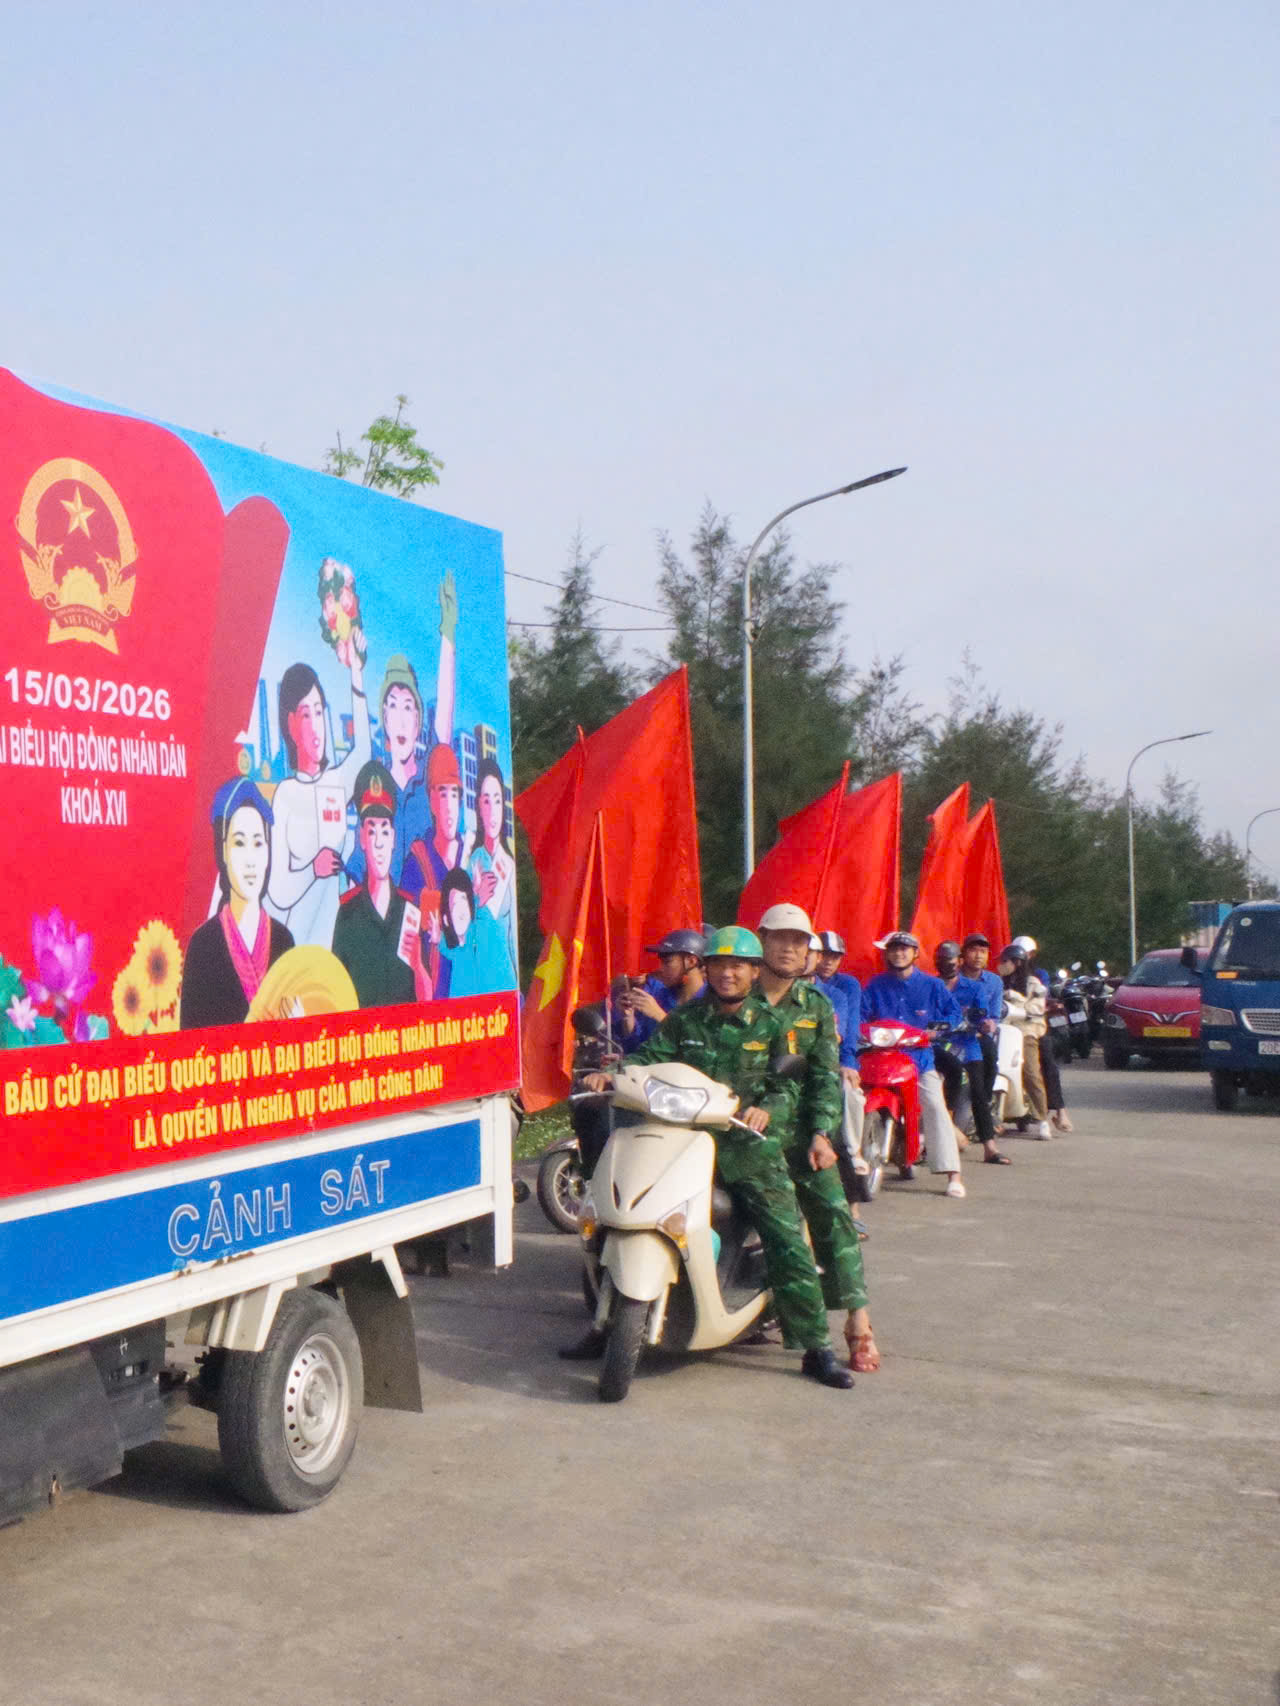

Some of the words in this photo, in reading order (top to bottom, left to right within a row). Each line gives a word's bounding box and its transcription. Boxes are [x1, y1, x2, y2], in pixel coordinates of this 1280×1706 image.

[5, 667, 171, 720] 15/03/2026
[10, 717, 45, 767] BIỂU
[48, 725, 74, 778] HỘI
[77, 725, 117, 772] ĐỒNG
[121, 730, 158, 777] NHÂN
[160, 734, 187, 778] DÂN
[61, 779, 103, 825] KHOÁ
[105, 789, 128, 826] XVI
[5, 1067, 48, 1115] BẦU
[54, 1063, 83, 1109] CỬ
[87, 1067, 119, 1107] ĐẠI
[124, 1051, 166, 1097] BIỂU
[171, 1046, 216, 1092] QUỐC
[221, 1045, 247, 1086] HỘI
[251, 1041, 272, 1077] VÀ
[275, 1041, 300, 1078] ĐẠI
[303, 1029, 335, 1069] BIỂU
[339, 1030, 361, 1066] HỘI
[364, 1024, 398, 1058] ĐỒNG
[401, 1021, 435, 1053] NHÂN
[437, 1017, 461, 1047] DÂN
[463, 1013, 485, 1042] CÁC
[487, 1006, 509, 1037] CẤP
[134, 1110, 157, 1149] LÀ
[161, 1099, 218, 1146] QUYỀN
[221, 1096, 243, 1132] VÀ
[246, 1089, 293, 1127] NGHĨA
[296, 1088, 315, 1121] VỤ
[319, 1075, 347, 1112] CỦA
[349, 1069, 376, 1106] MỖI
[378, 1068, 412, 1100] CÔNG
[414, 1062, 444, 1093] DÂN!
[168, 1180, 291, 1257] CẢNH
[320, 1153, 390, 1216] SÁT
